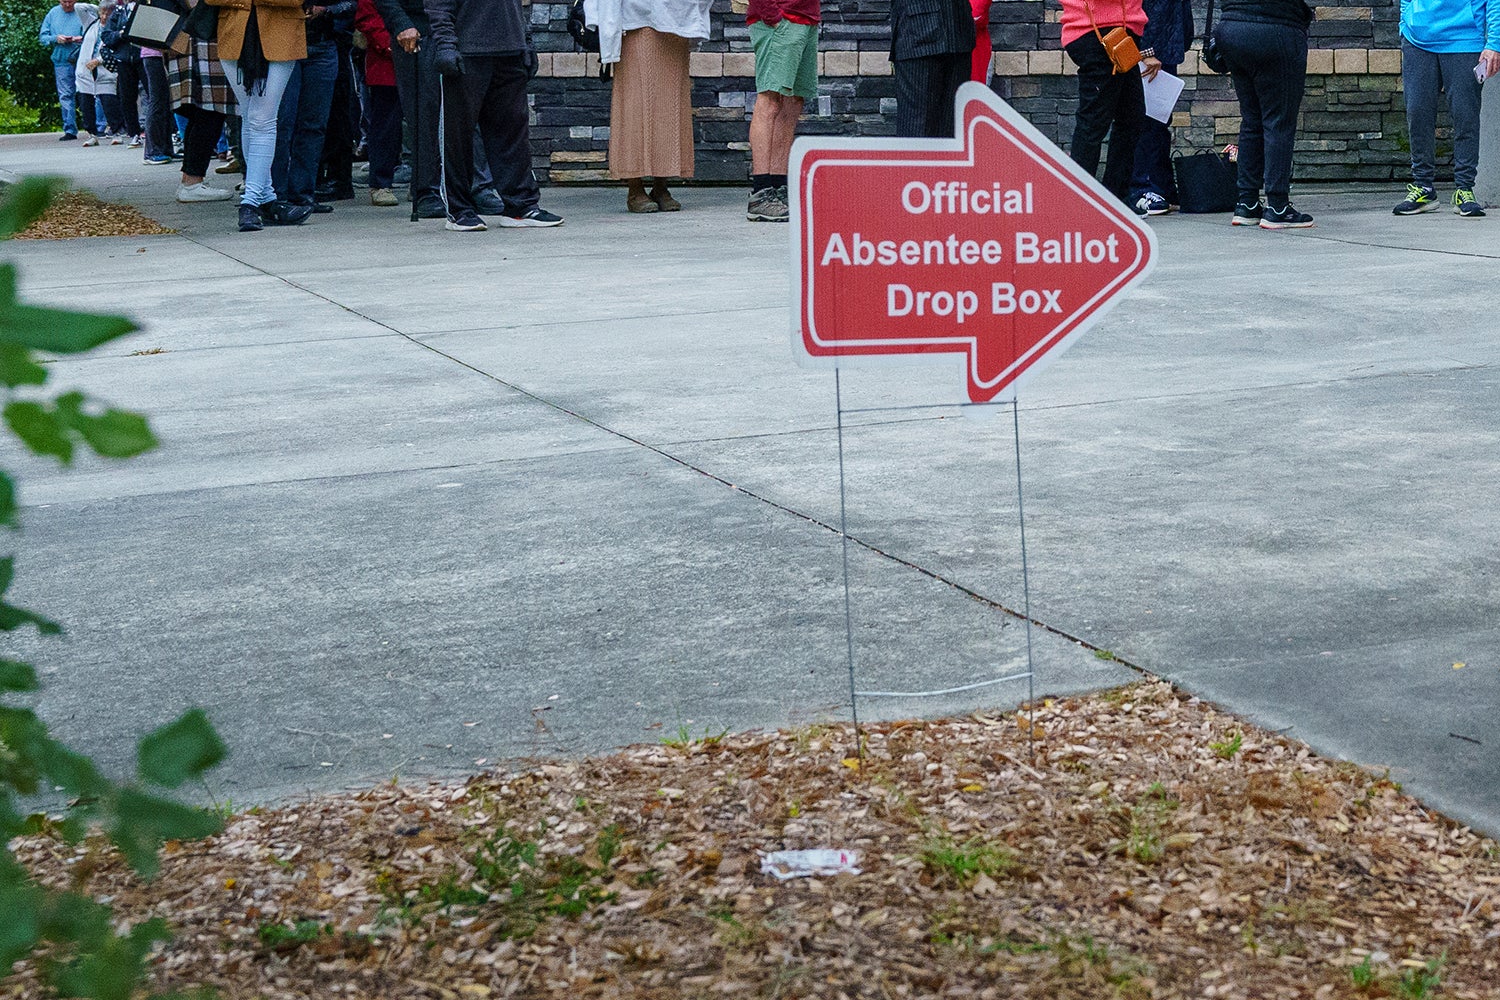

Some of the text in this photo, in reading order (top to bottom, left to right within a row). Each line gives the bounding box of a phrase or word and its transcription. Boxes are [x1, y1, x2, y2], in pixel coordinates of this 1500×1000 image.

[900, 181, 1034, 215] Official
[821, 231, 1120, 267] Absentee Ballot
[887, 282, 1063, 324] Drop Box
